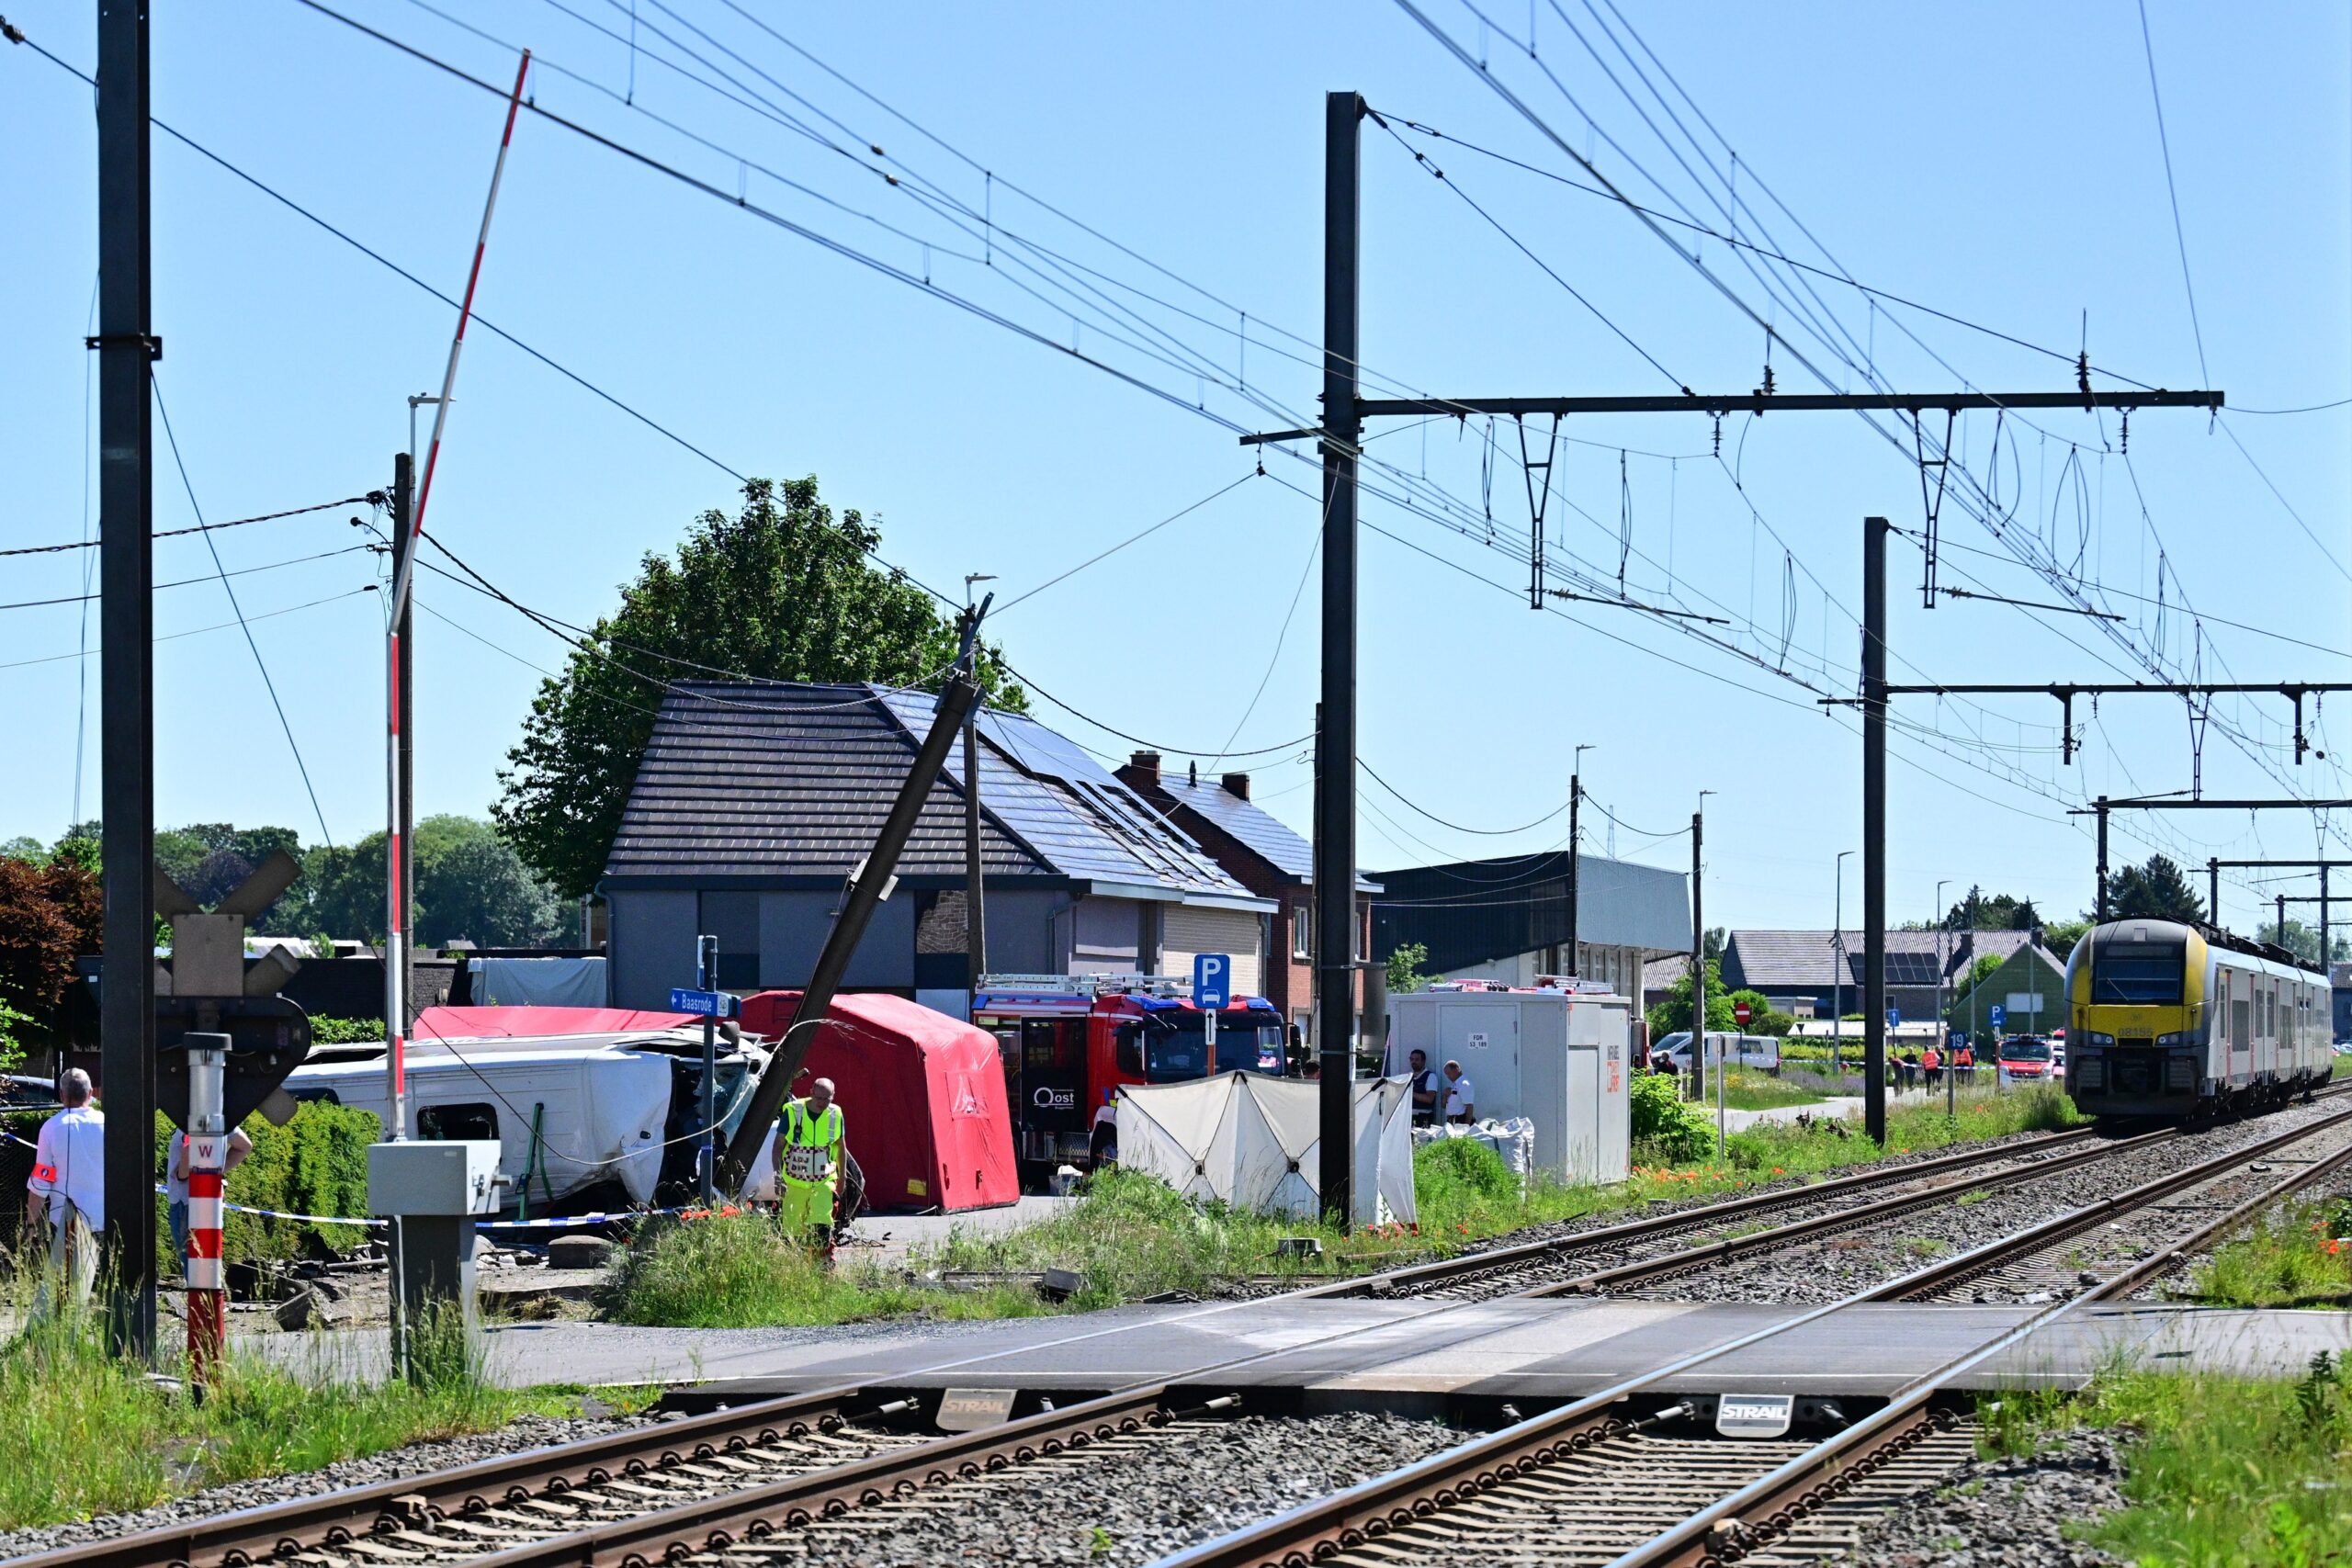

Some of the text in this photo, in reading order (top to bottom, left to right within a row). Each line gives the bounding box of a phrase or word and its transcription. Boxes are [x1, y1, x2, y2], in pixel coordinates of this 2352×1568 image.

[1202, 957, 1222, 987] P
[682, 993, 712, 1012] Baasrode
[1992, 1005, 2001, 1018] P
[1950, 1033, 1964, 1047] 19
[1034, 1087, 1075, 1108] Oost
[198, 1145, 213, 1158] W
[944, 1400, 1008, 1413] STRAIL
[1722, 1405, 1788, 1419] STRAIL
